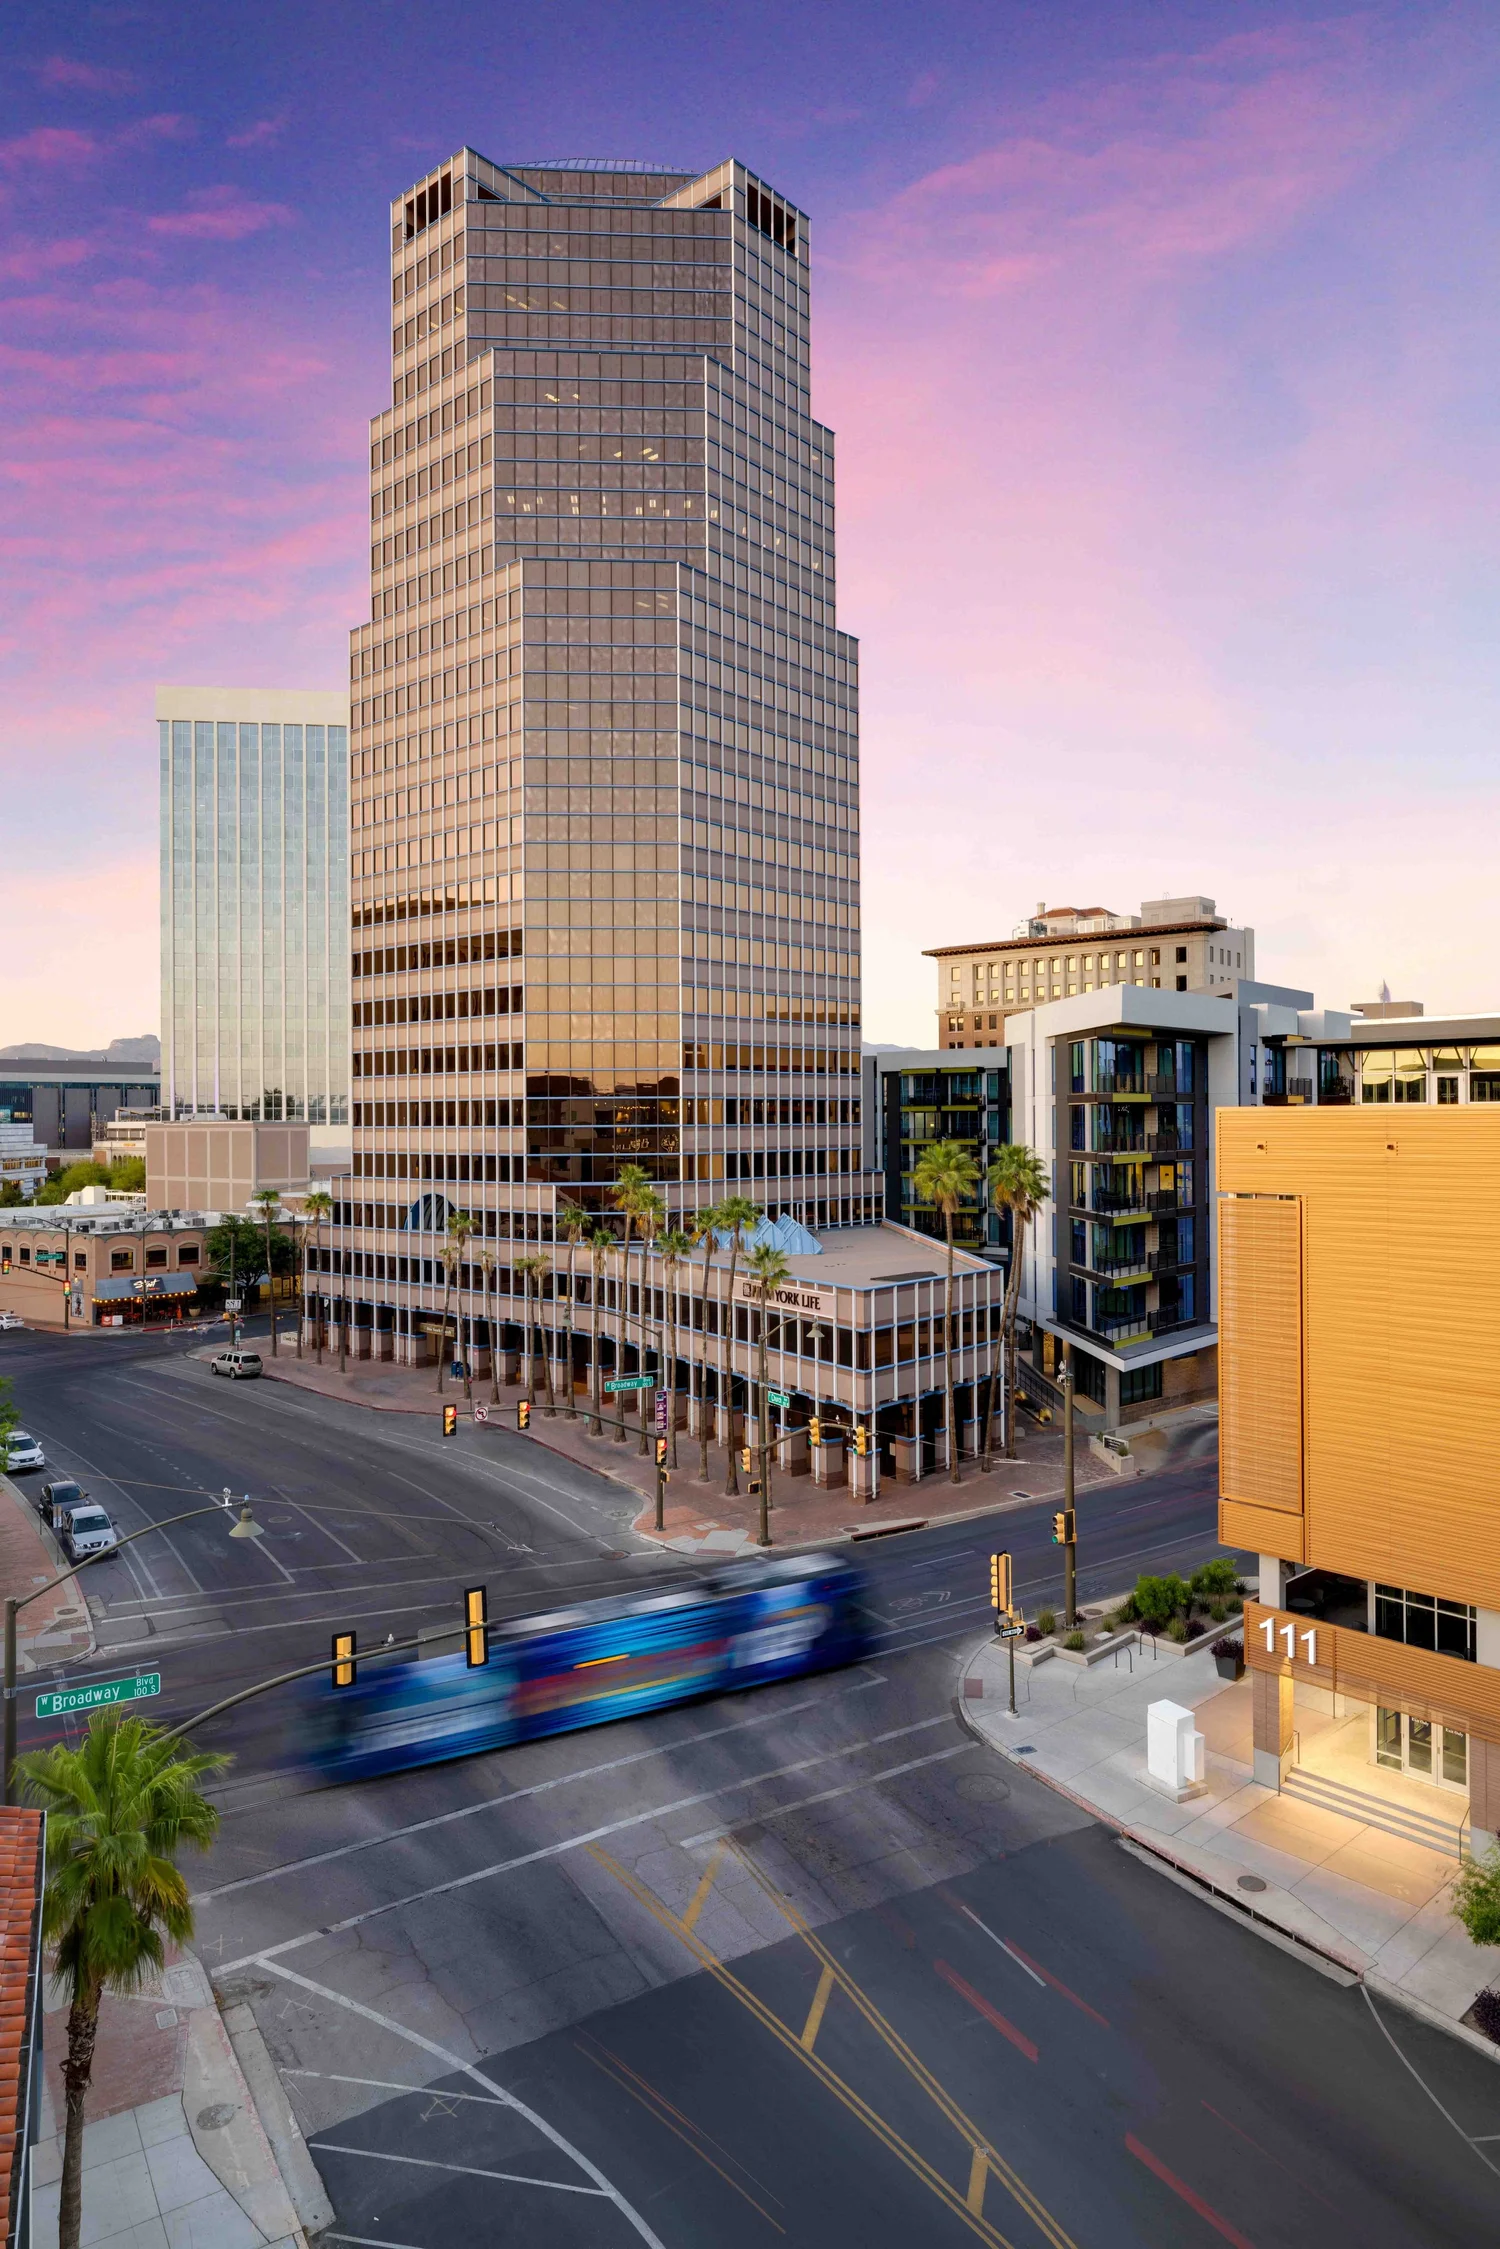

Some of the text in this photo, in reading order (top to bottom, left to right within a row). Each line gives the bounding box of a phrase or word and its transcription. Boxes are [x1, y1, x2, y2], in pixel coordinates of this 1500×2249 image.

[775, 1289, 800, 1307] YORK
[802, 1294, 821, 1311] LIFE
[611, 1381, 638, 1390] Broadway
[1259, 1616, 1317, 1665] 111
[136, 1676, 154, 1687] Blvd
[41, 1686, 120, 1712] W Broadway
[134, 1685, 156, 1697] 100 S
